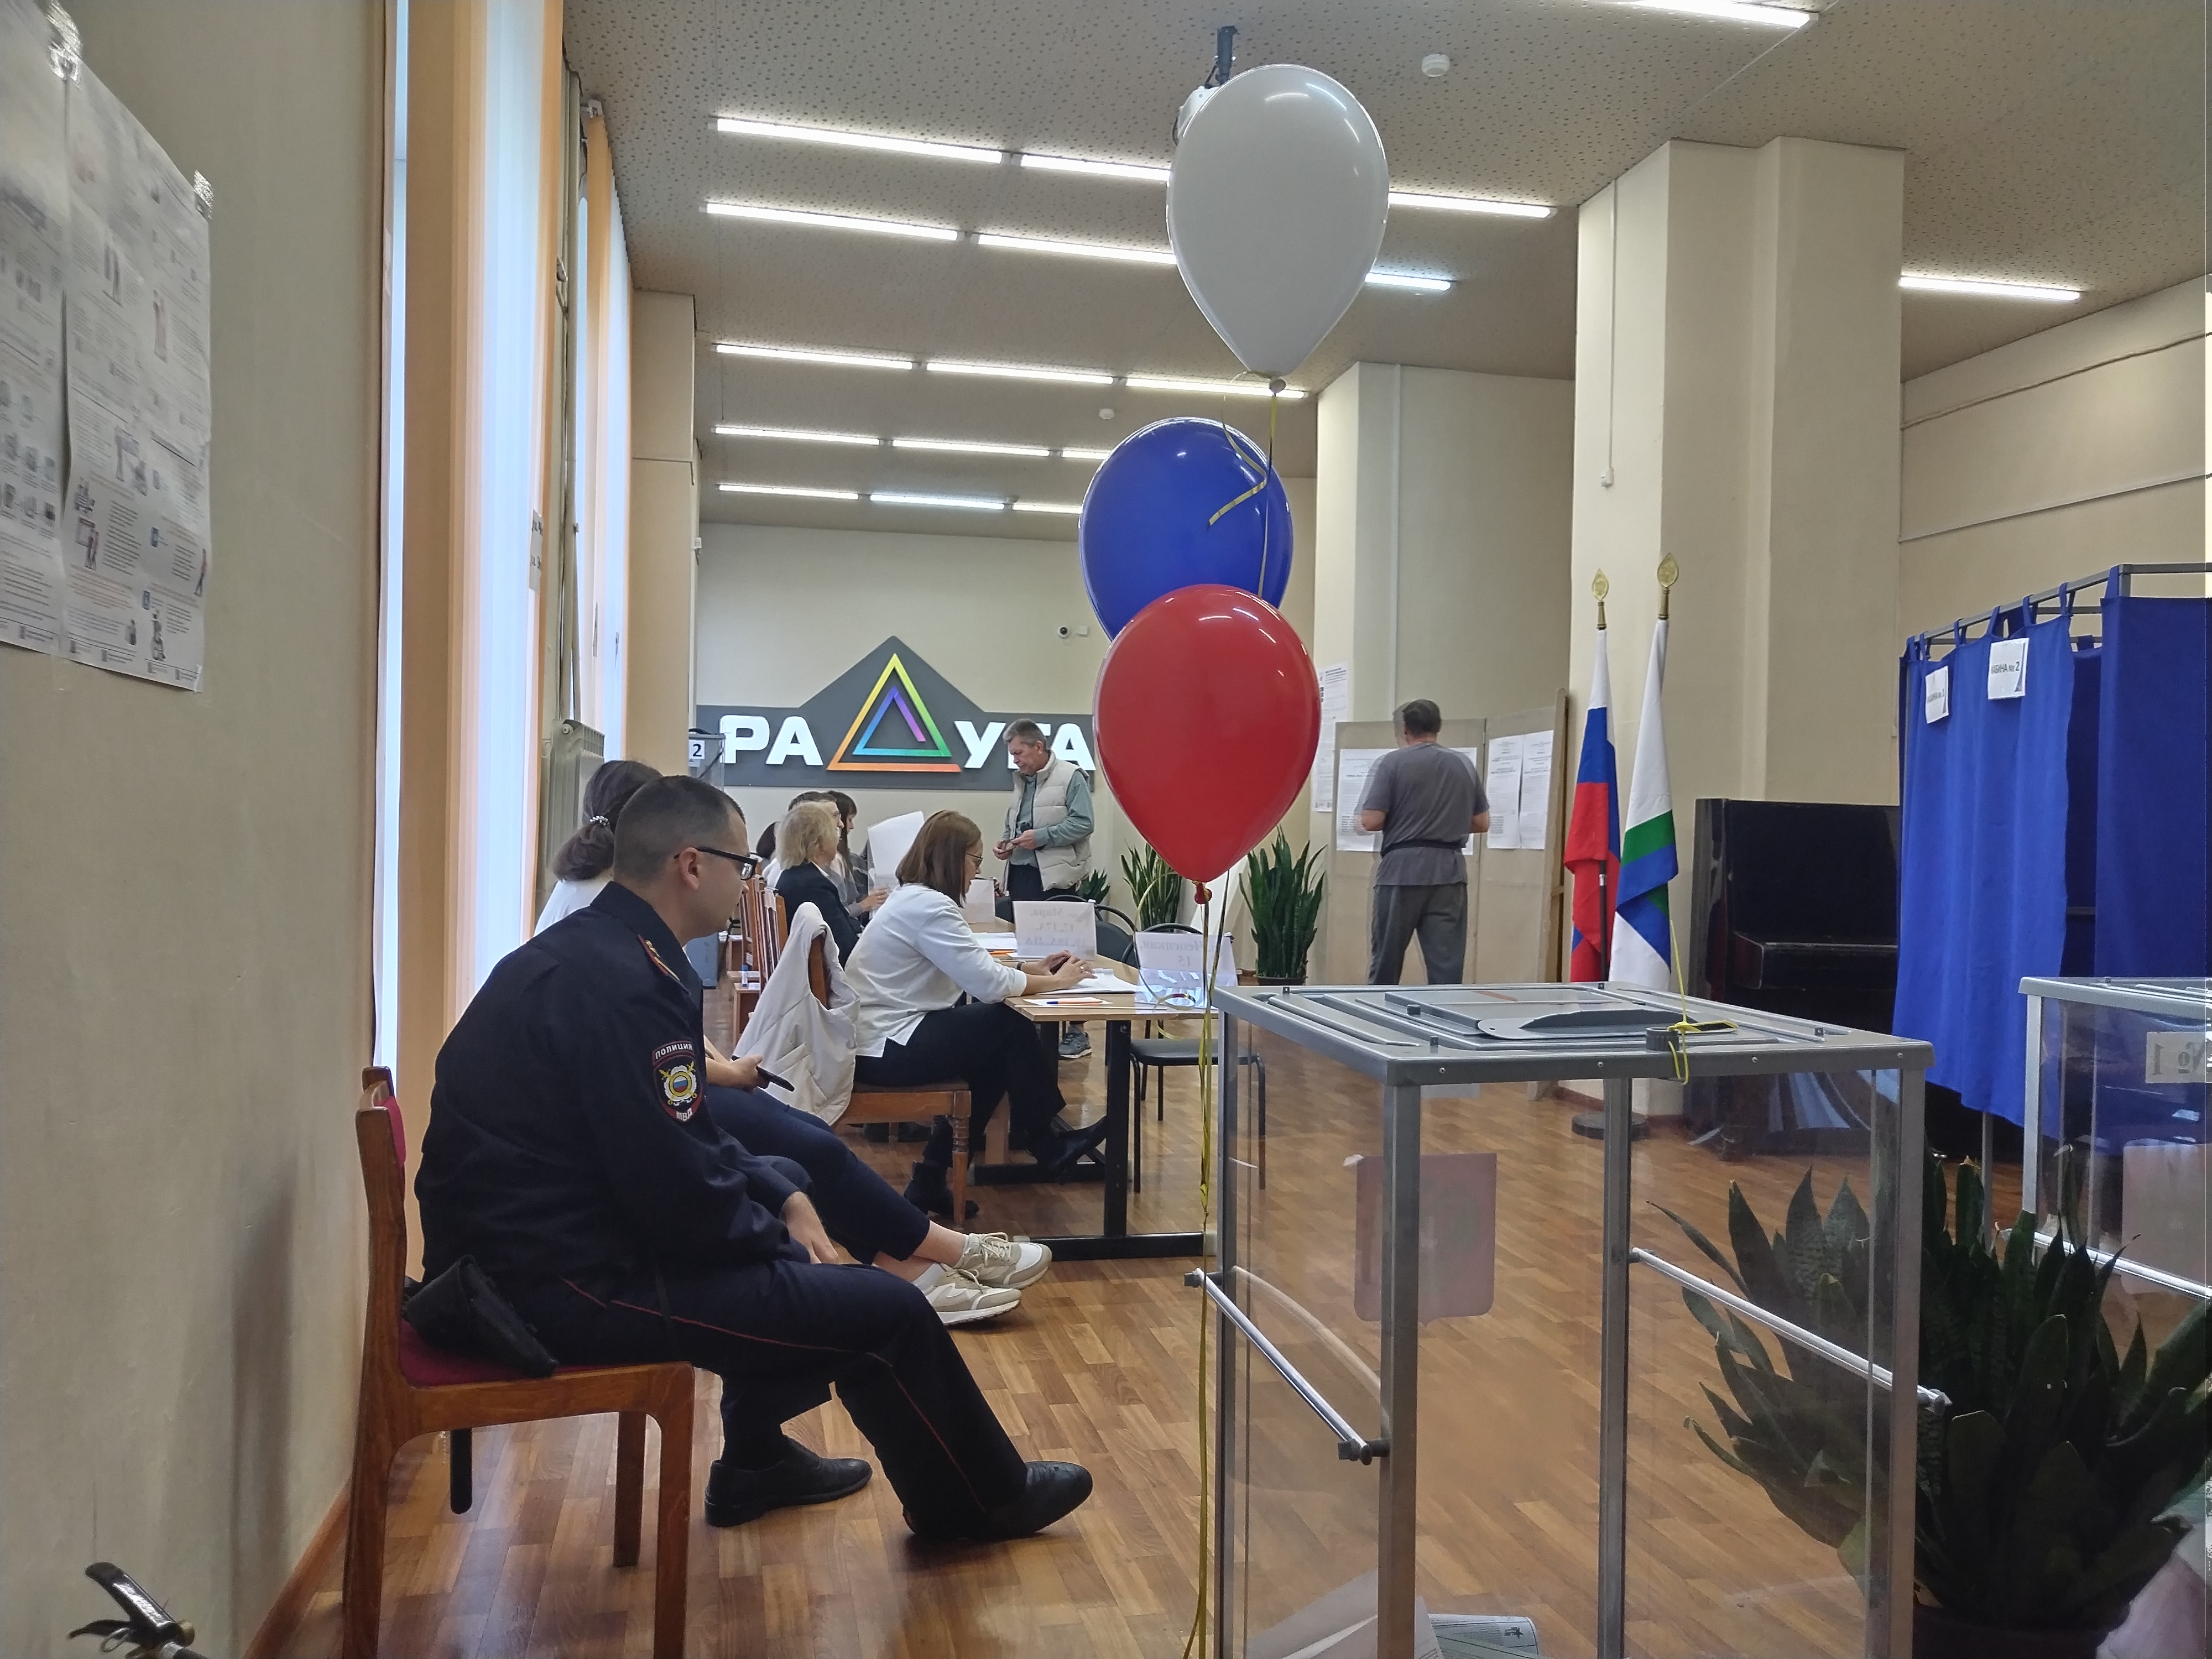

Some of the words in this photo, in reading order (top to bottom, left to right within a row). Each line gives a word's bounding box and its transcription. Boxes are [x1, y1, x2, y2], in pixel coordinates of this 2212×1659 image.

[2015, 661, 2020, 671] 2
[693, 743, 702, 757] 2
[655, 1043, 692, 1059] ПОЛИЦИЯ
[676, 1108, 692, 1121] МВД
